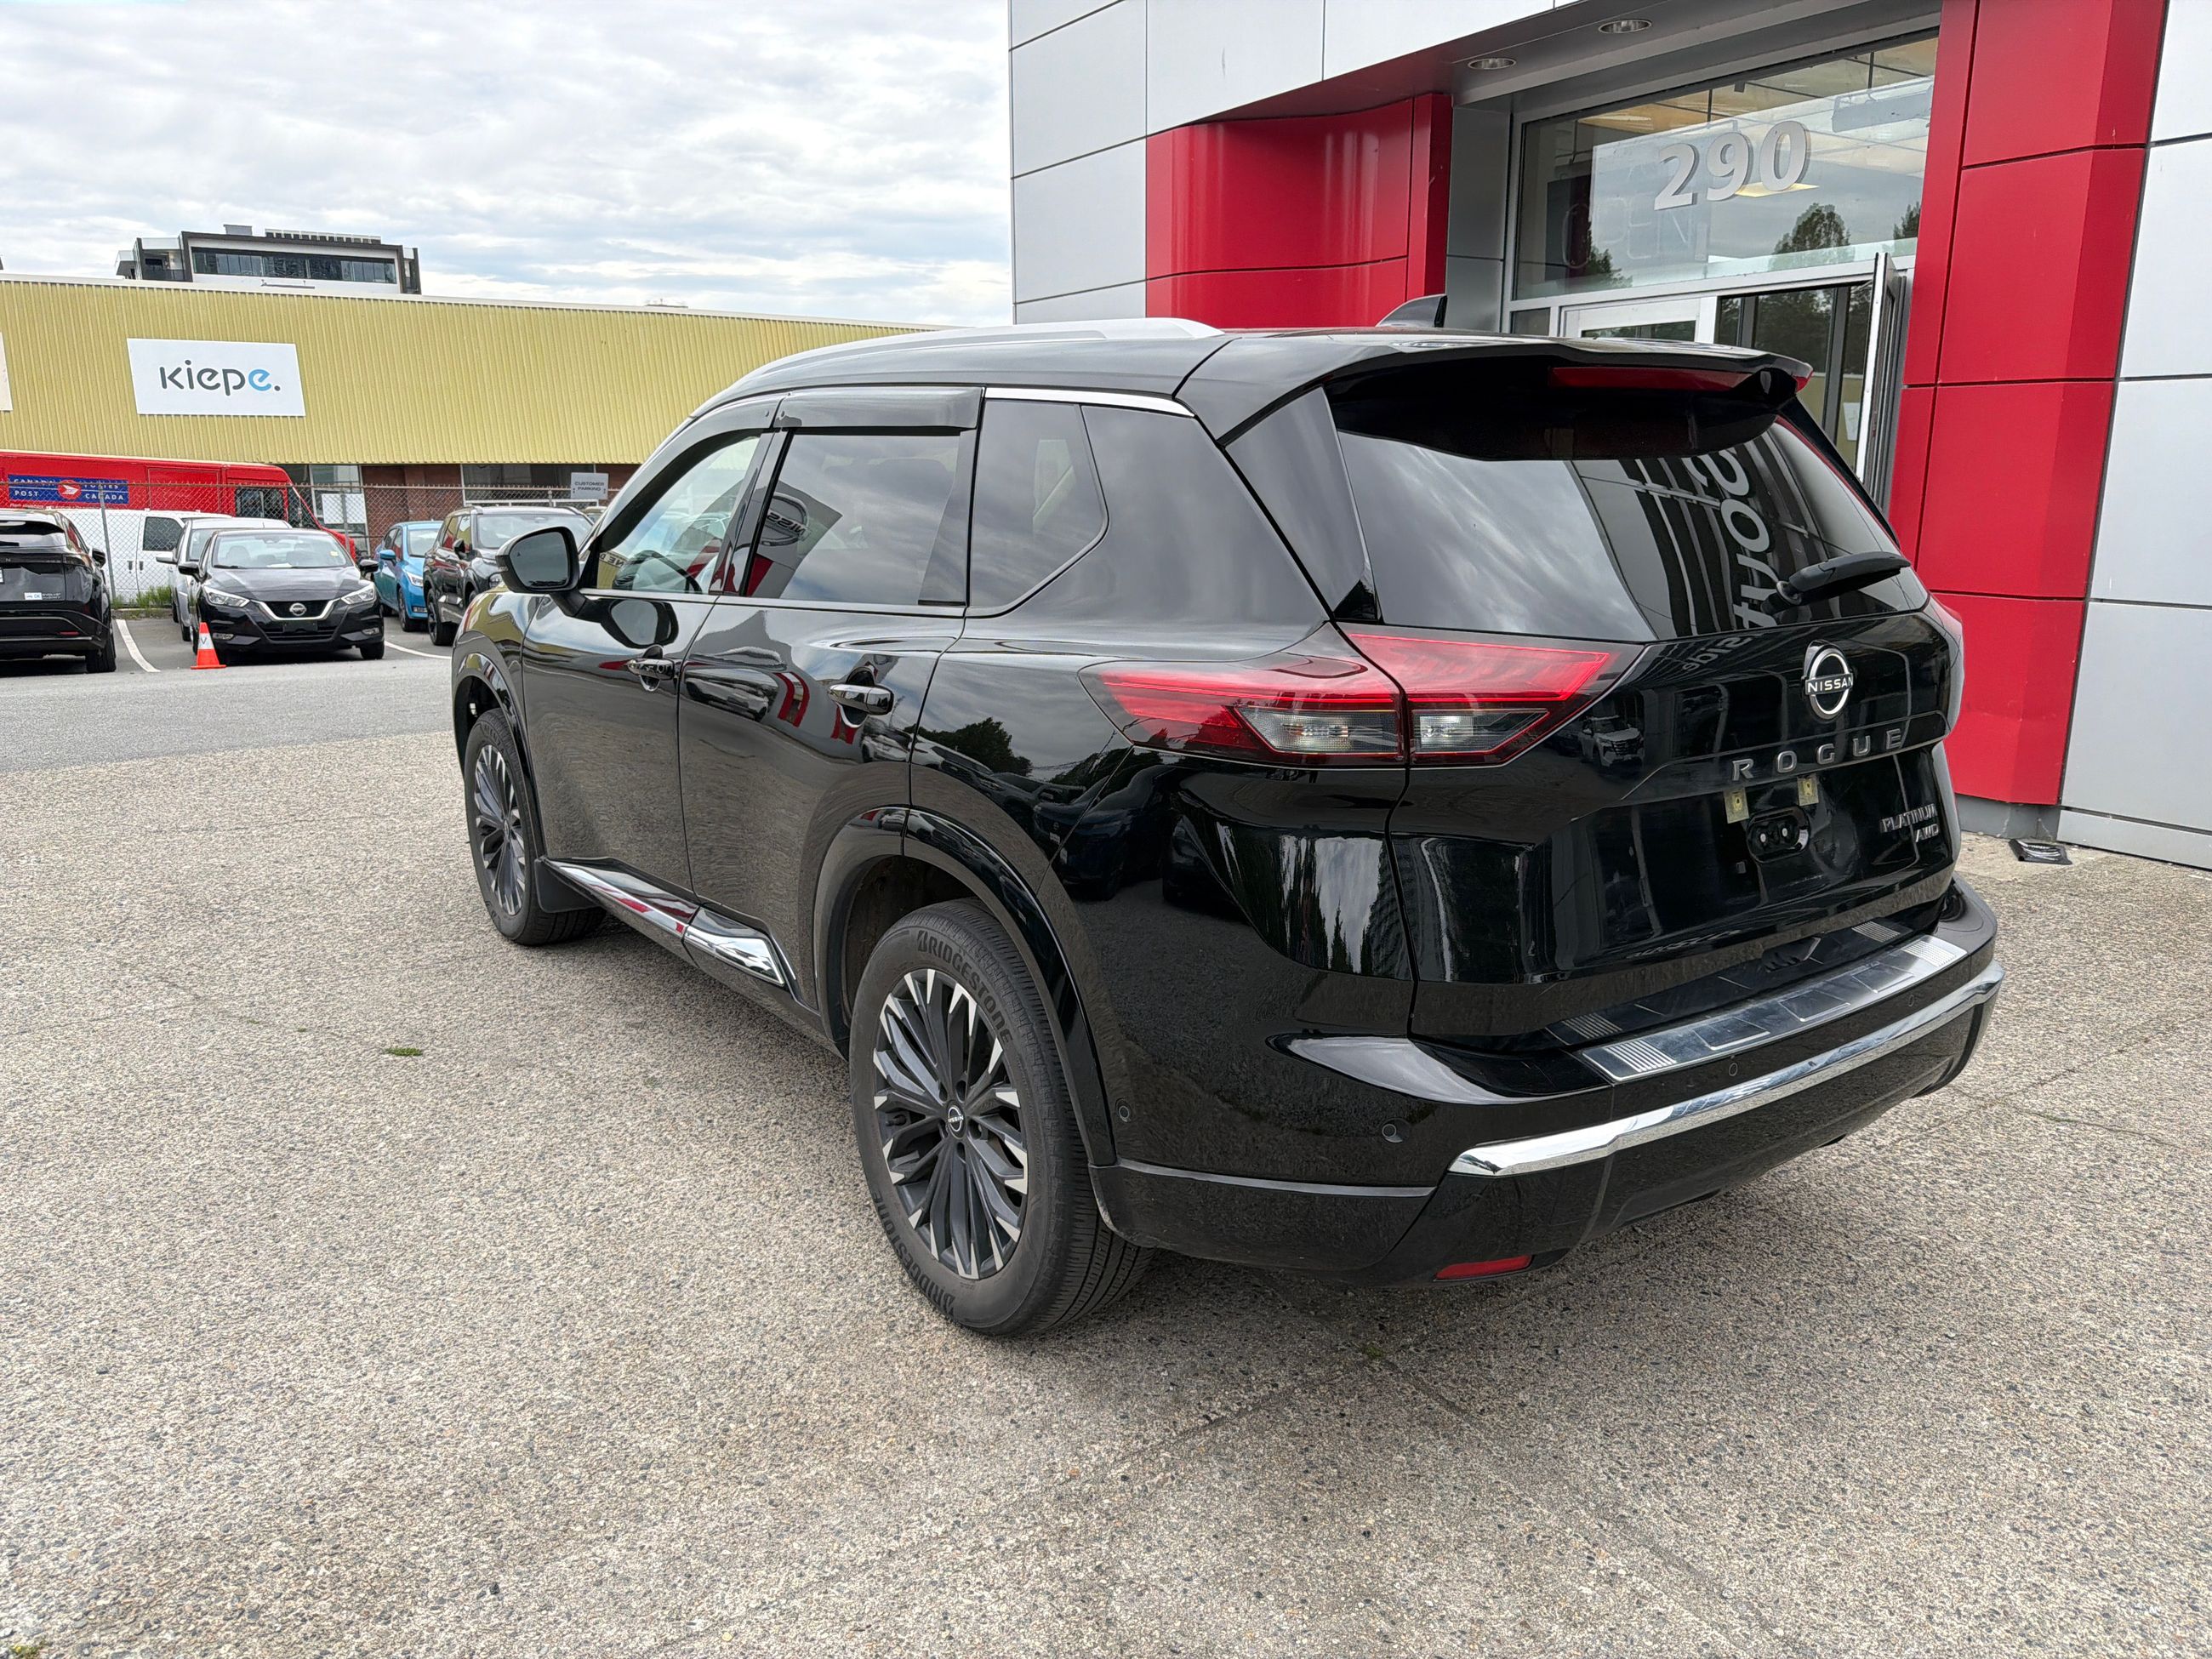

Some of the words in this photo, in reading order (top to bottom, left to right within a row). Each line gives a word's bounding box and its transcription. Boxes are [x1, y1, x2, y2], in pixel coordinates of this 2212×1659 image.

[1654, 121, 1810, 211] 290
[1807, 676, 1854, 693] NISSAN
[1731, 728, 1904, 782] ROGUE
[1880, 803, 1938, 833] PLATINUM
[1915, 823, 1939, 843] AWD
[916, 929, 1012, 1044] BRIDGESTONE
